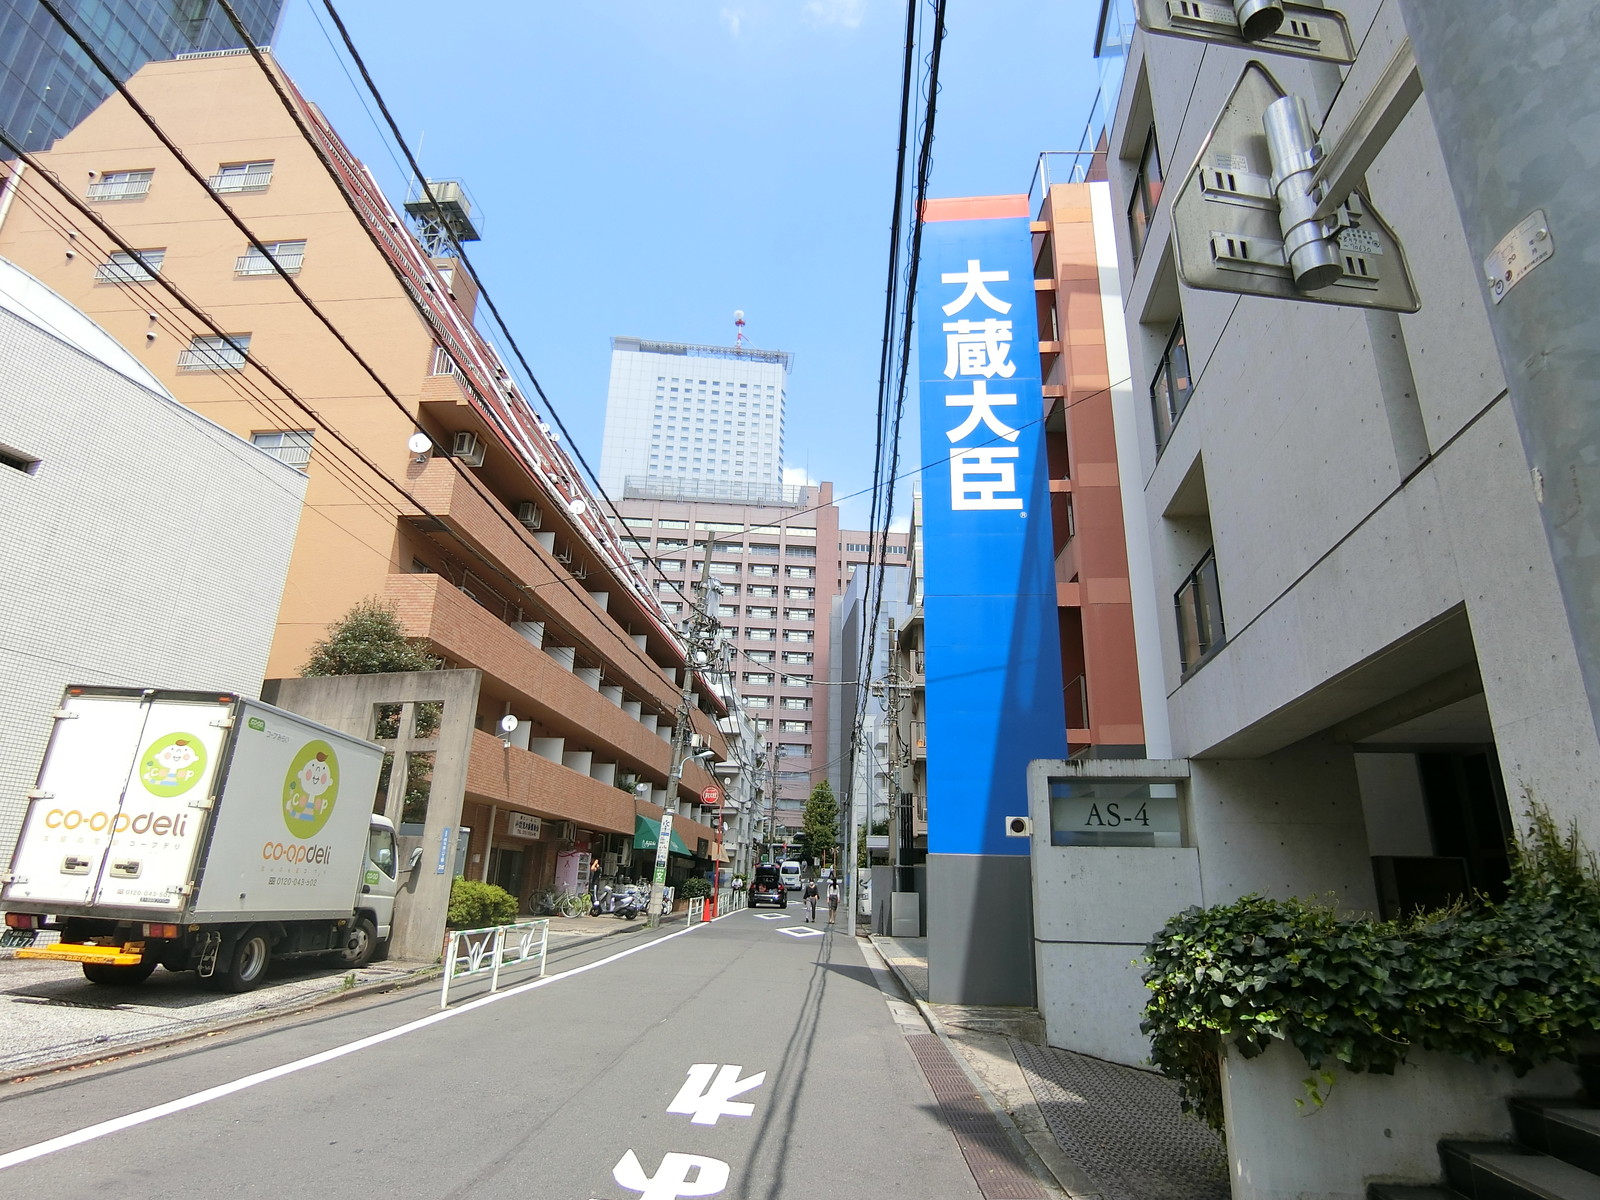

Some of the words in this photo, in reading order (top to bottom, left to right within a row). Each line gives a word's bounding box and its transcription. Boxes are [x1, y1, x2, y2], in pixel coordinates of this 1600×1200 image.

[941, 259, 1023, 511] 大蔵大臣
[1084, 802, 1150, 827] AS-4
[7, 936, 35, 947] 14-72
